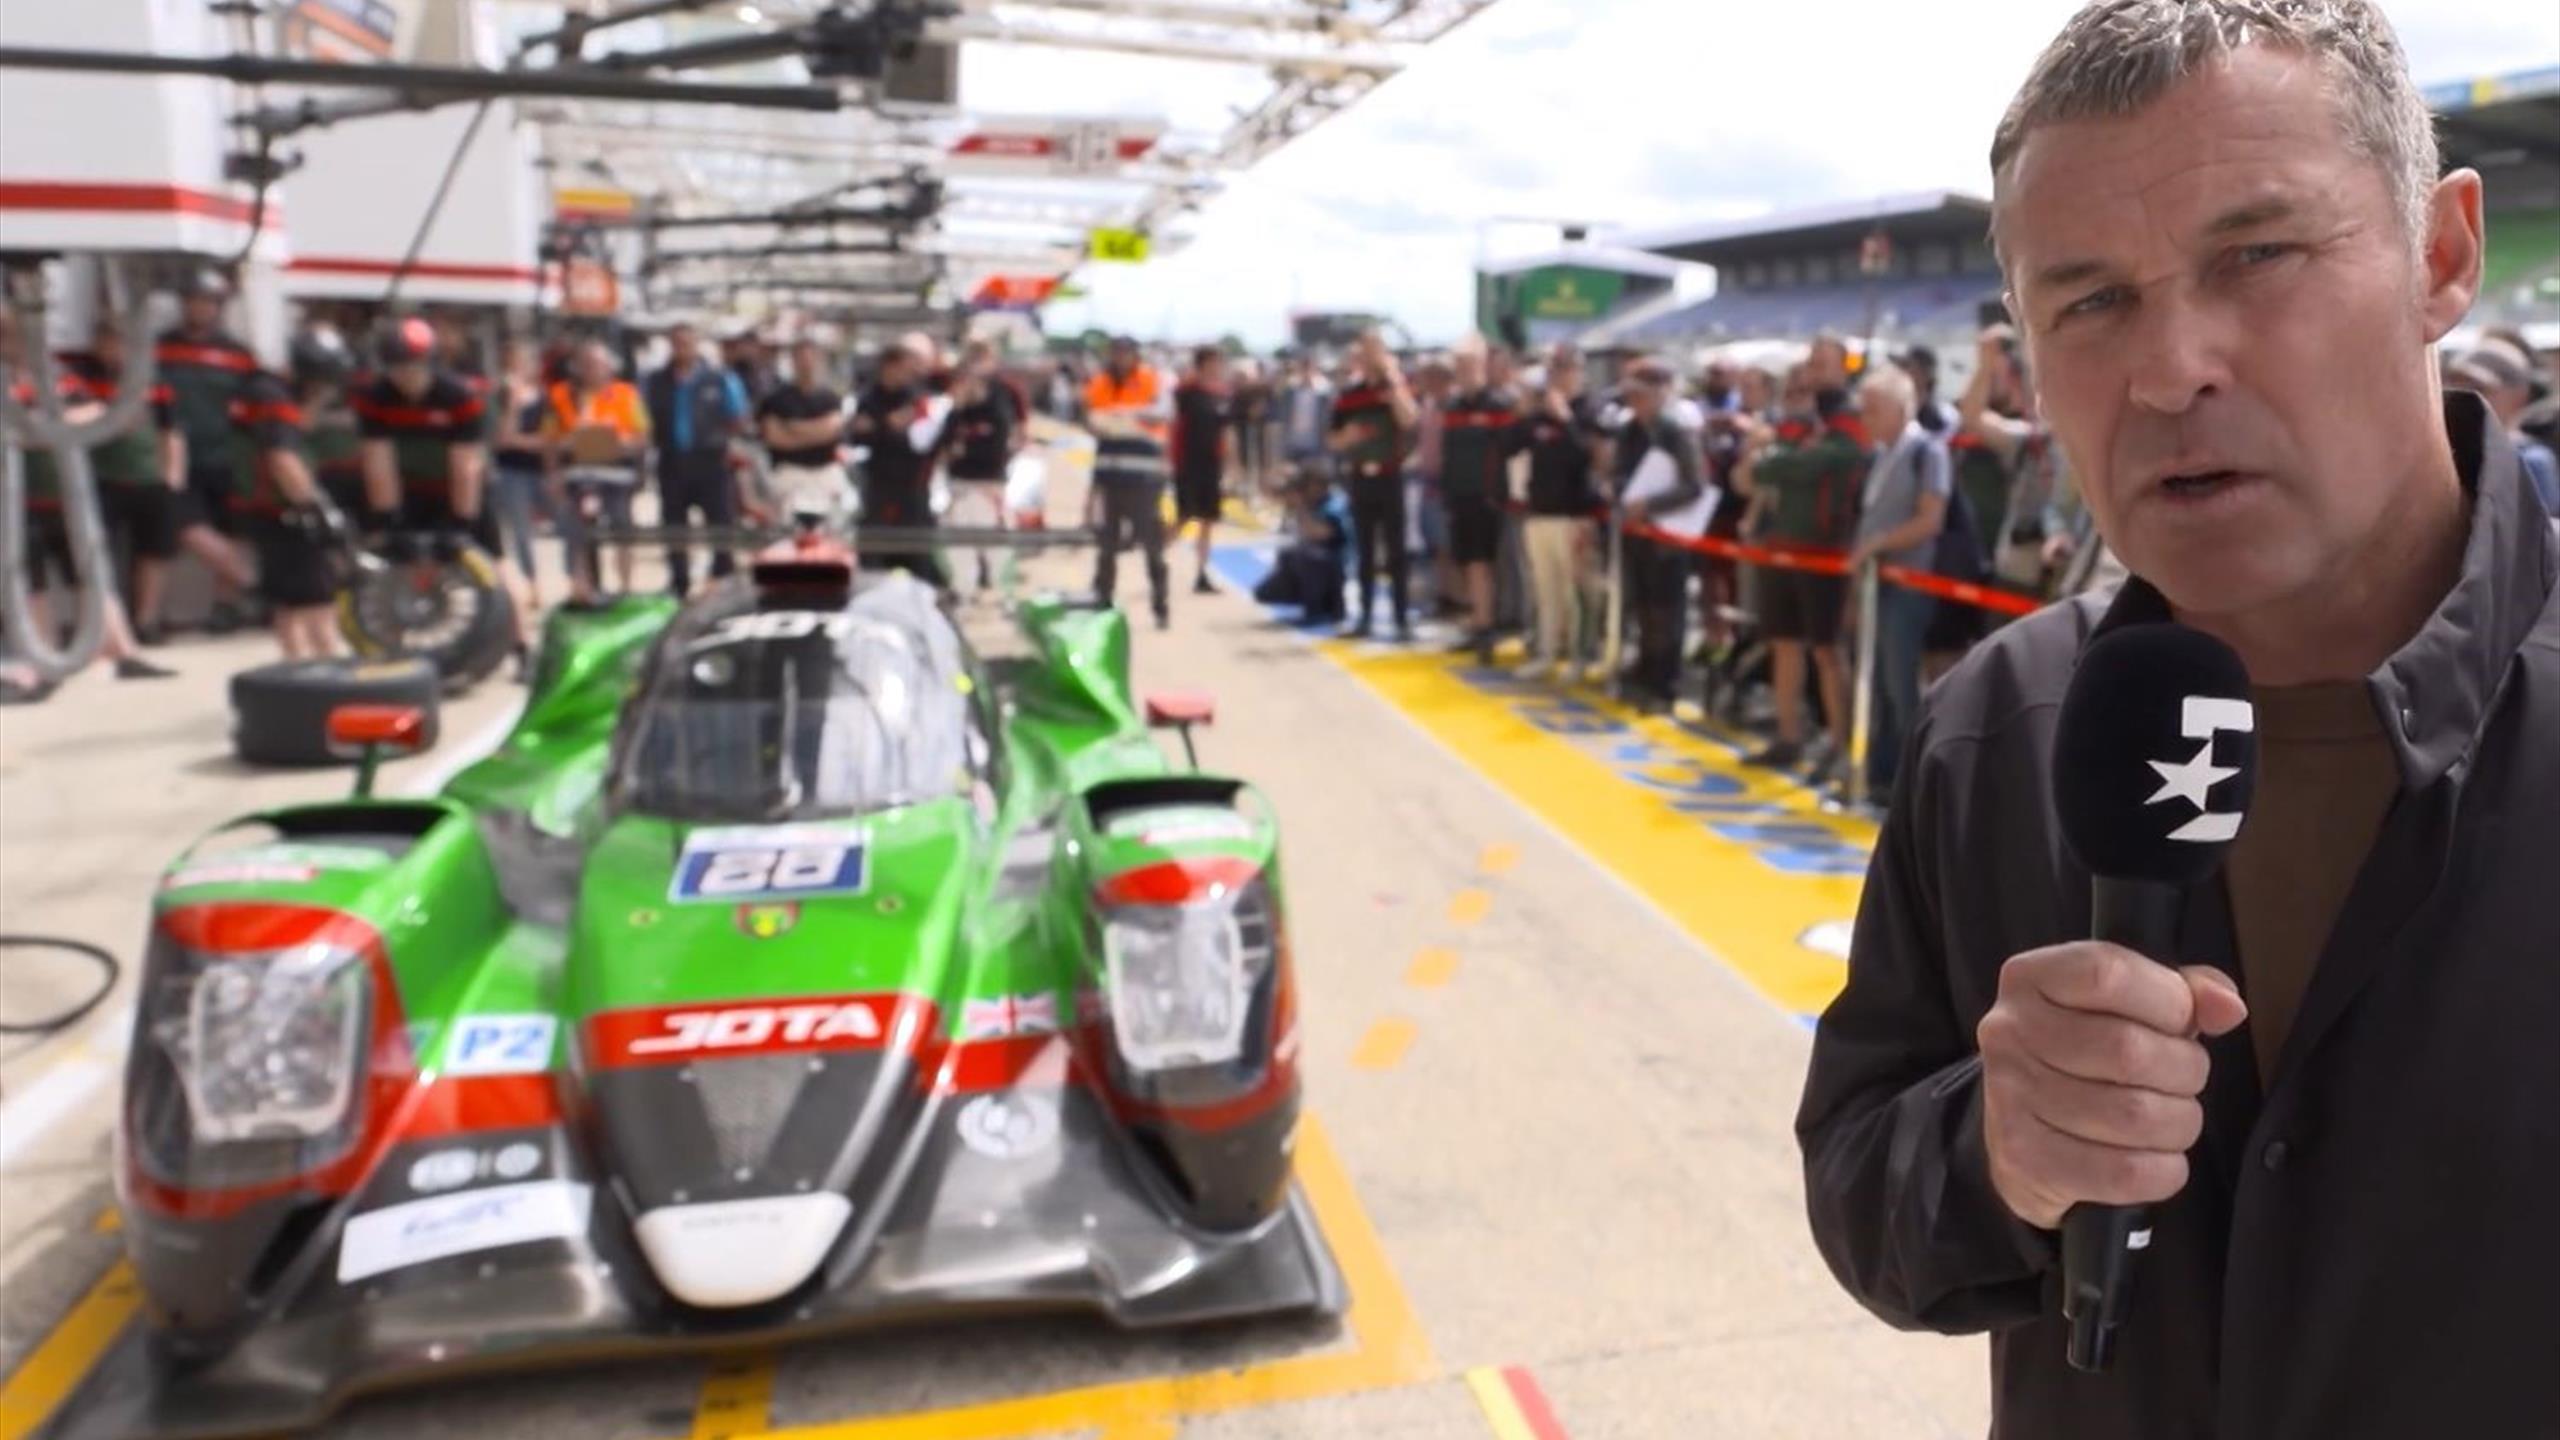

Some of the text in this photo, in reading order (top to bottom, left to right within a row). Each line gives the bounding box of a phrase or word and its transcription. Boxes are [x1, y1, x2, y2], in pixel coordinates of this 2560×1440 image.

[682, 609, 900, 652] JOT
[459, 1026, 544, 1060] P2
[628, 1003, 880, 1054] JOTA
